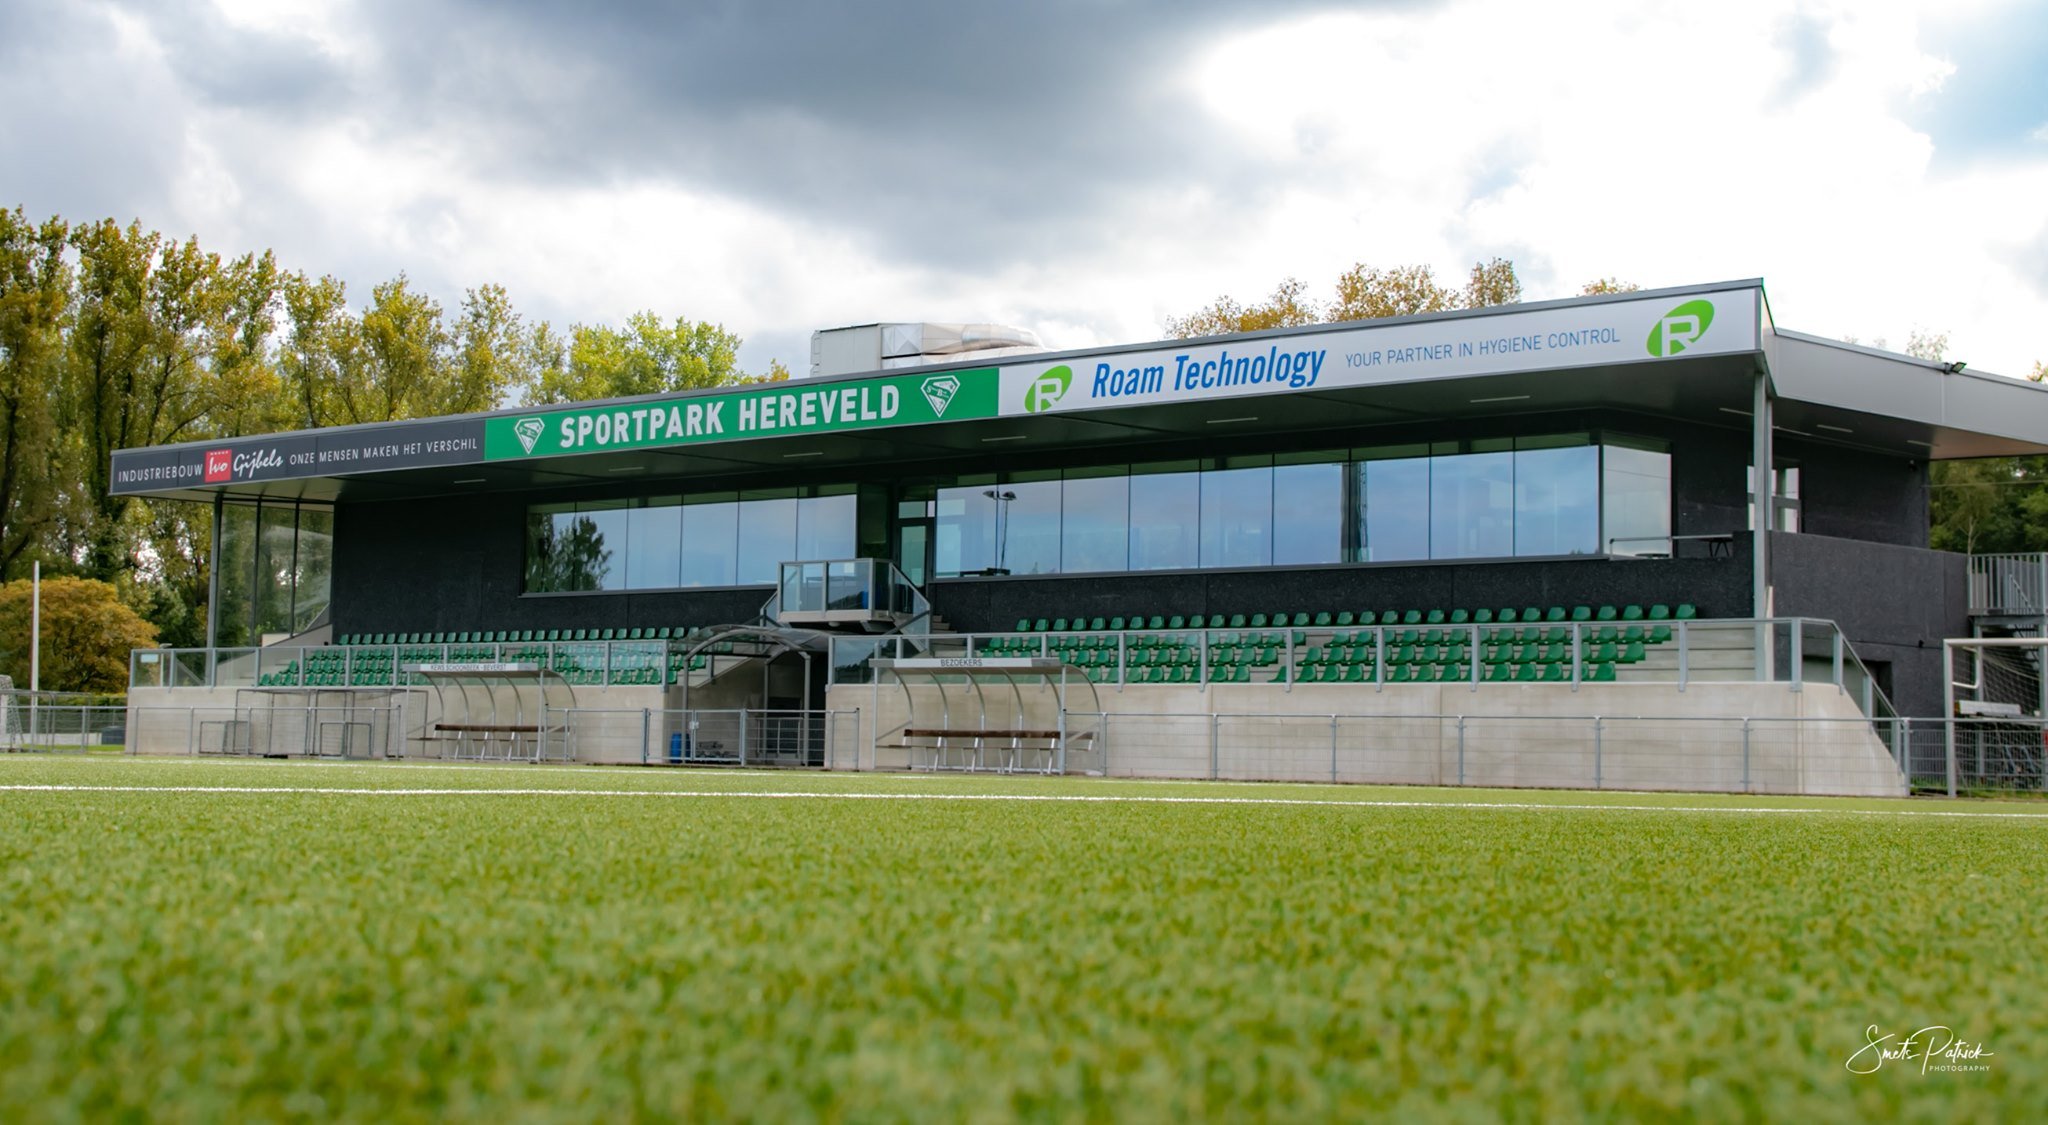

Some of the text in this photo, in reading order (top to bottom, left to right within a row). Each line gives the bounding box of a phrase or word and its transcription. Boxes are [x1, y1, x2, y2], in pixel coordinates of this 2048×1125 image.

[1345, 327, 1621, 369] YOUR PARTNER IN HYGIENE CONTROL
[1092, 346, 1327, 398] Roam Technology
[560, 385, 900, 449] SPORTPARK HEREVELD
[118, 438, 478, 483] INDUSTRIEBOUW Ivo Gijbels ONZE MENSEN MAKEN HET VERSCHIL
[940, 659, 982, 667] BEZOEKERS
